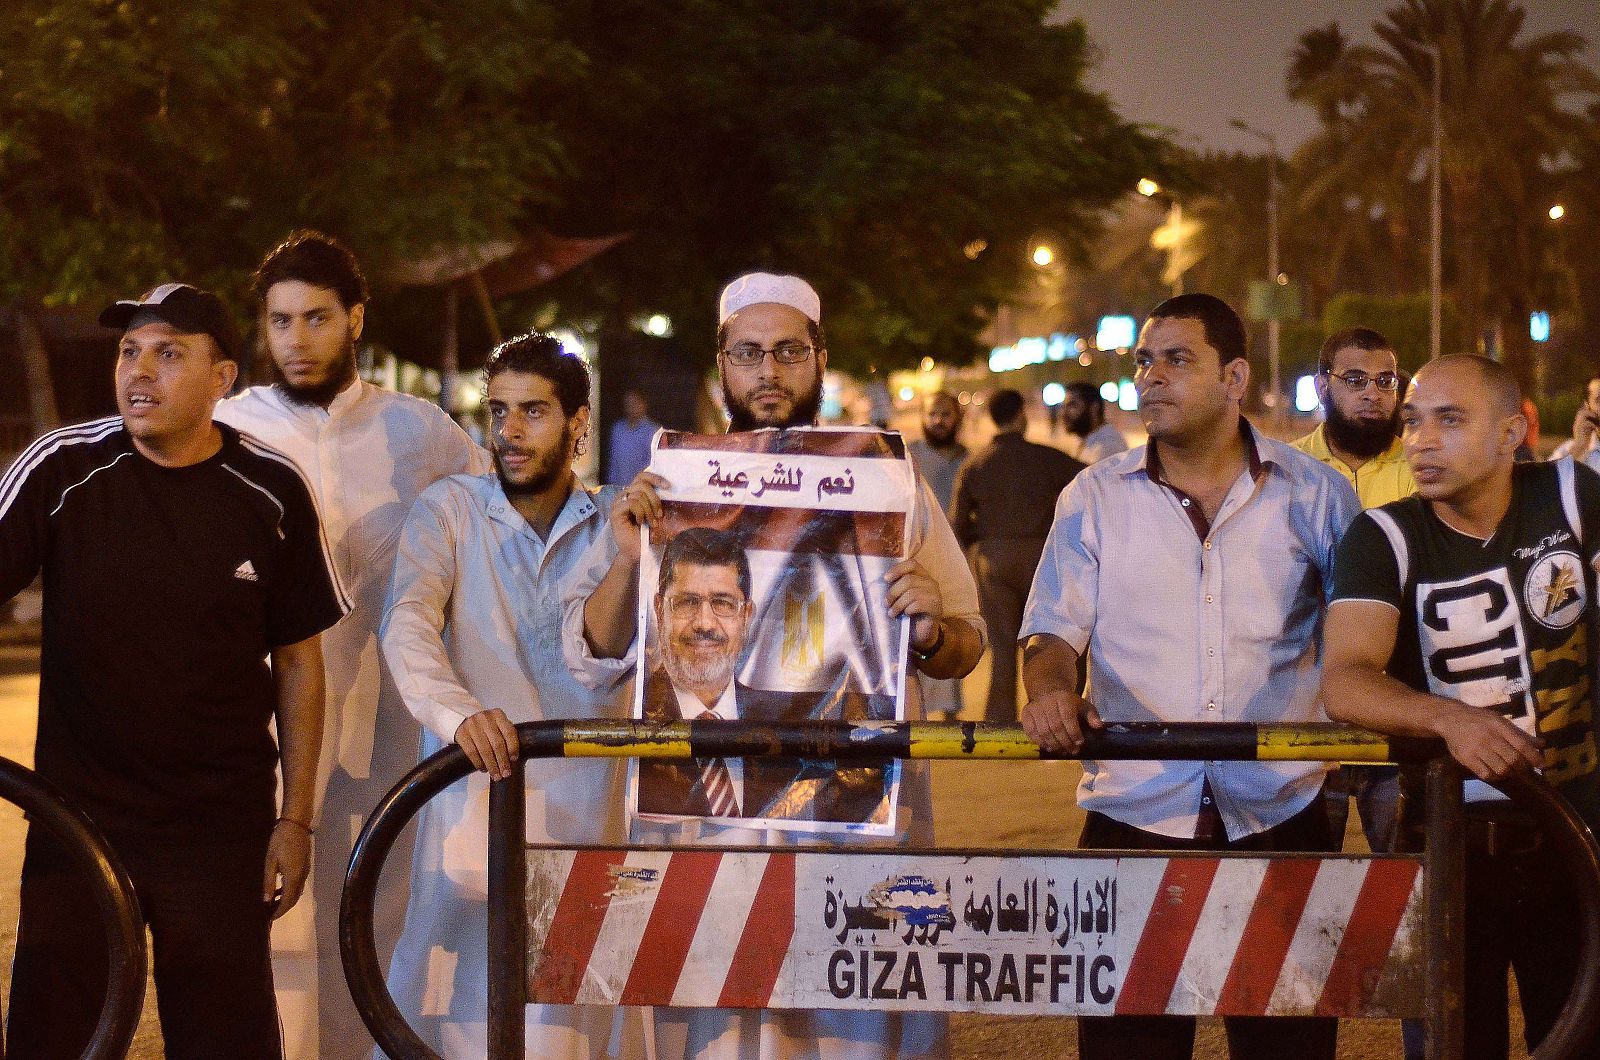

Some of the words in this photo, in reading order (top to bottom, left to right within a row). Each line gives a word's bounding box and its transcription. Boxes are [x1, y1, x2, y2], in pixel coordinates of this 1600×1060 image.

[707, 460, 804, 498] للشرعية
[817, 467, 856, 502] نعم
[1422, 578, 1529, 719] CU
[964, 876, 1038, 936] العامة
[1044, 876, 1118, 949] الإدارة
[827, 949, 927, 1000] GIZA
[938, 951, 1116, 1004] TRAFFIC
